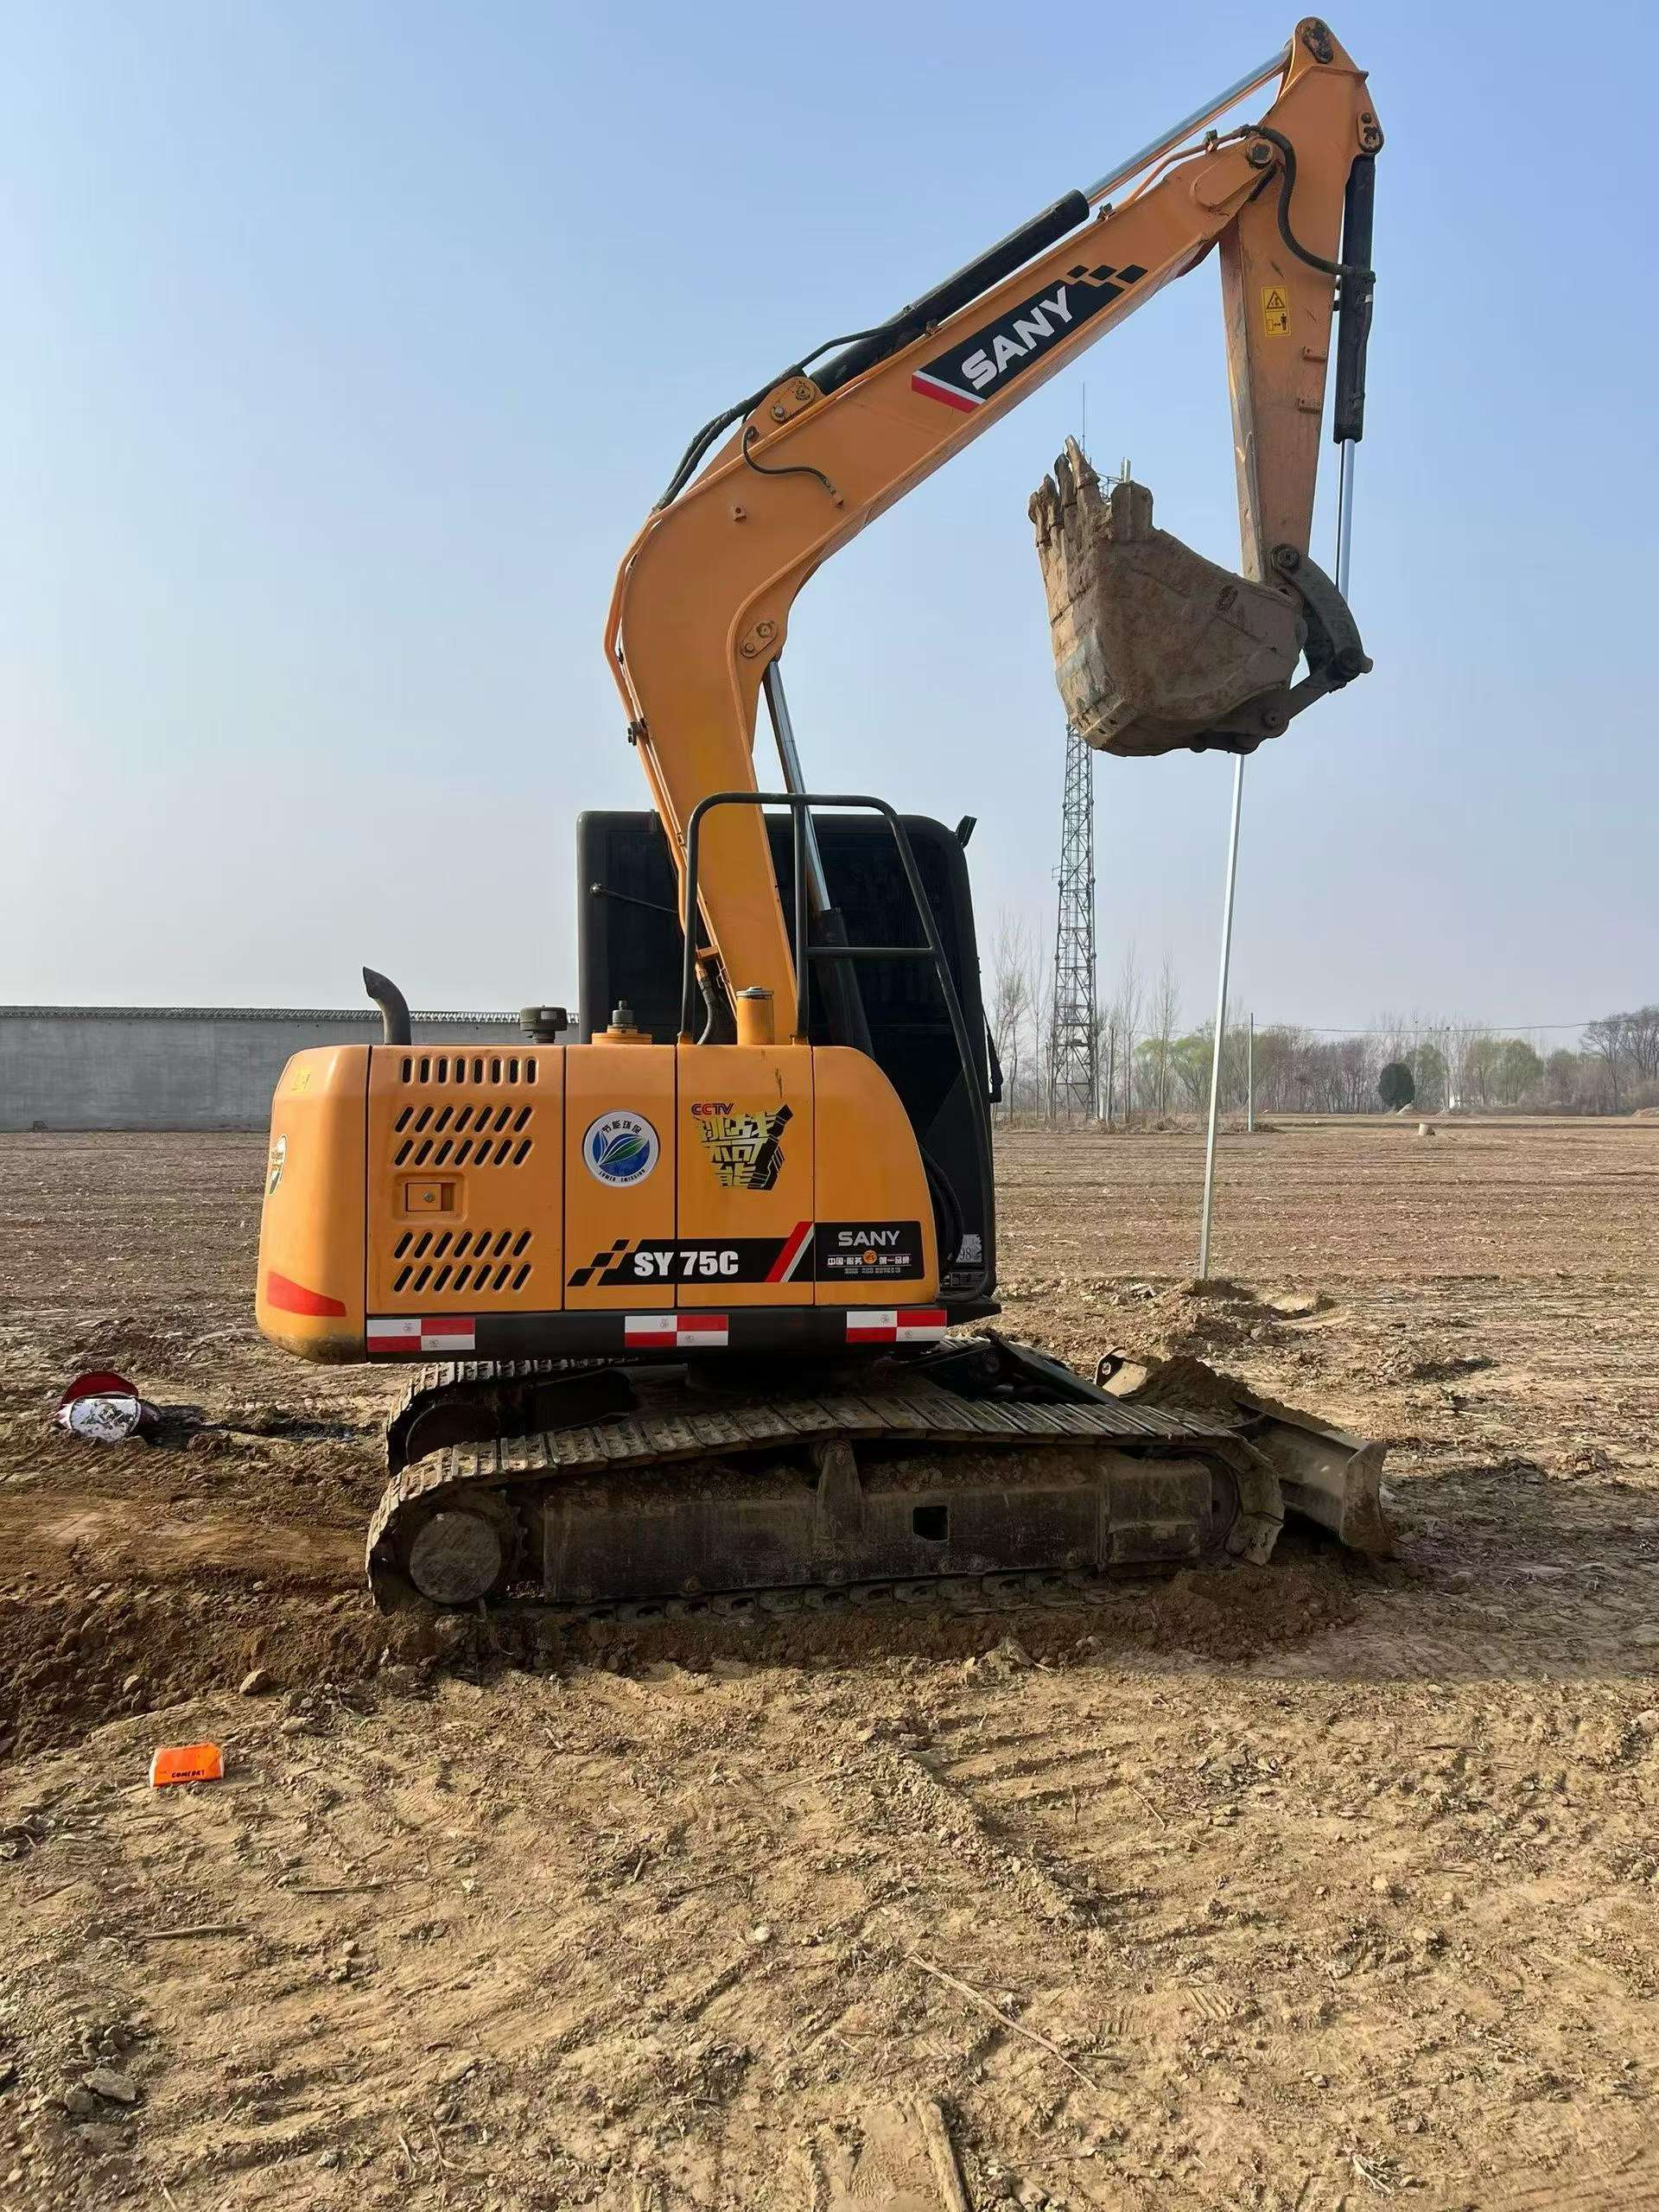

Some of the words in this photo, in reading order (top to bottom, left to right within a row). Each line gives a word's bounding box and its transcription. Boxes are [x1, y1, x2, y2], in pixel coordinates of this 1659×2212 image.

[961, 285, 1073, 391] SANY
[691, 1103, 734, 1116] CCTV
[601, 1119, 642, 1135] 节能环保
[696, 1110, 778, 1141] 挑战
[701, 1137, 769, 1164] 不可
[837, 1230, 900, 1246] SANY
[633, 1251, 675, 1277] SY
[679, 1250, 739, 1275] 75C
[171, 1769, 206, 1778] COMFORT
